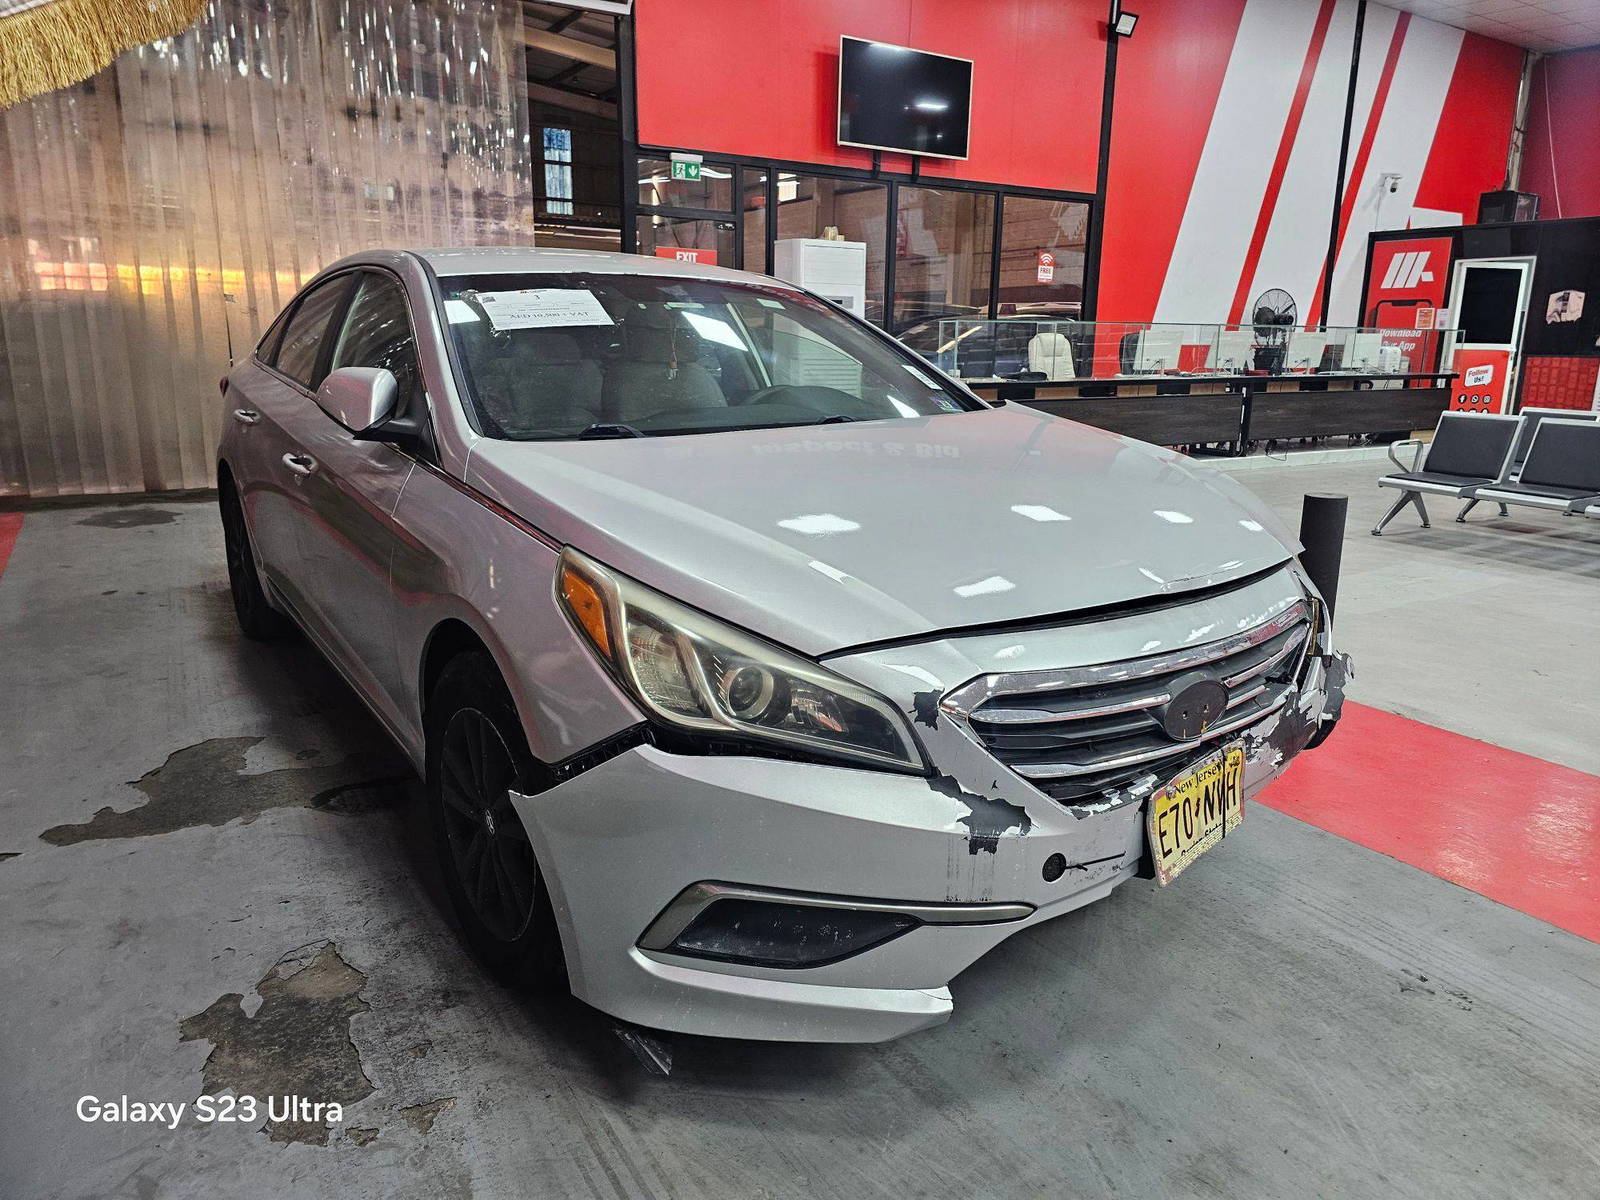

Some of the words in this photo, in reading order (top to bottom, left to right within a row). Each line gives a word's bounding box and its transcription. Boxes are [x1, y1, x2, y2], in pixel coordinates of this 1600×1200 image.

[676, 251, 698, 264] EXIT
[1399, 340, 1416, 351] App
[1173, 777, 1194, 796] New
